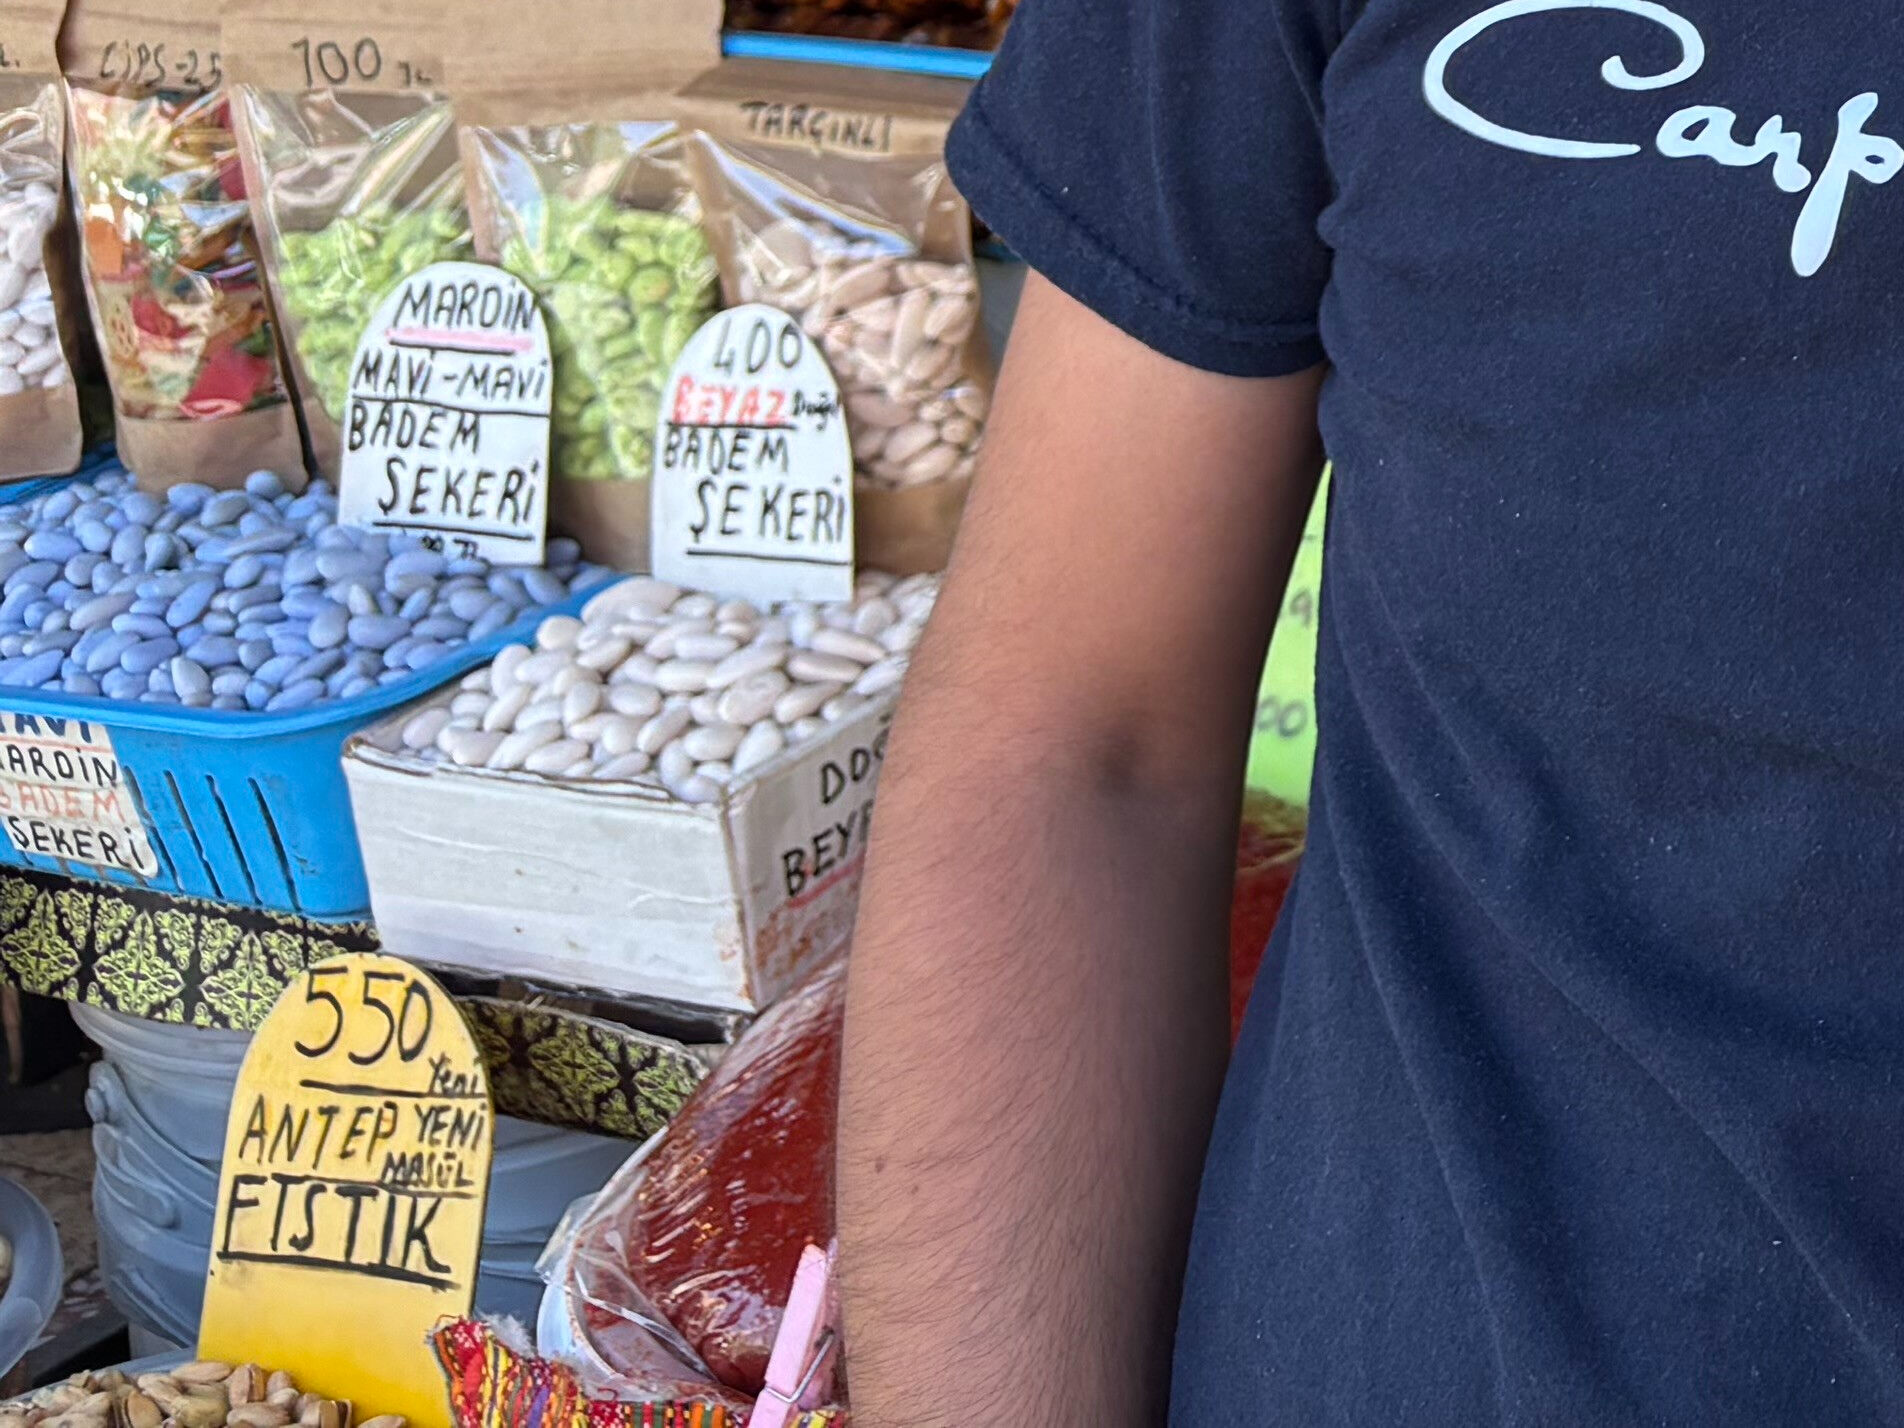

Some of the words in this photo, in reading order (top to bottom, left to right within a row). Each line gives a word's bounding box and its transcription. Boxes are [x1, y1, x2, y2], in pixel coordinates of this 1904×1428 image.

[292, 37, 382, 87] 100
[713, 316, 803, 379] 400
[347, 400, 482, 455] BADEM
[672, 374, 788, 426] BEYAZ
[664, 429, 790, 476] BADEM
[376, 455, 542, 527] ŞEKERİ
[689, 473, 846, 545] ŞEKERİ
[0, 744, 118, 790] ARDİN
[294, 966, 433, 1066] 550
[238, 1093, 400, 1171] ANTEP
[414, 1100, 488, 1152] YENİ
